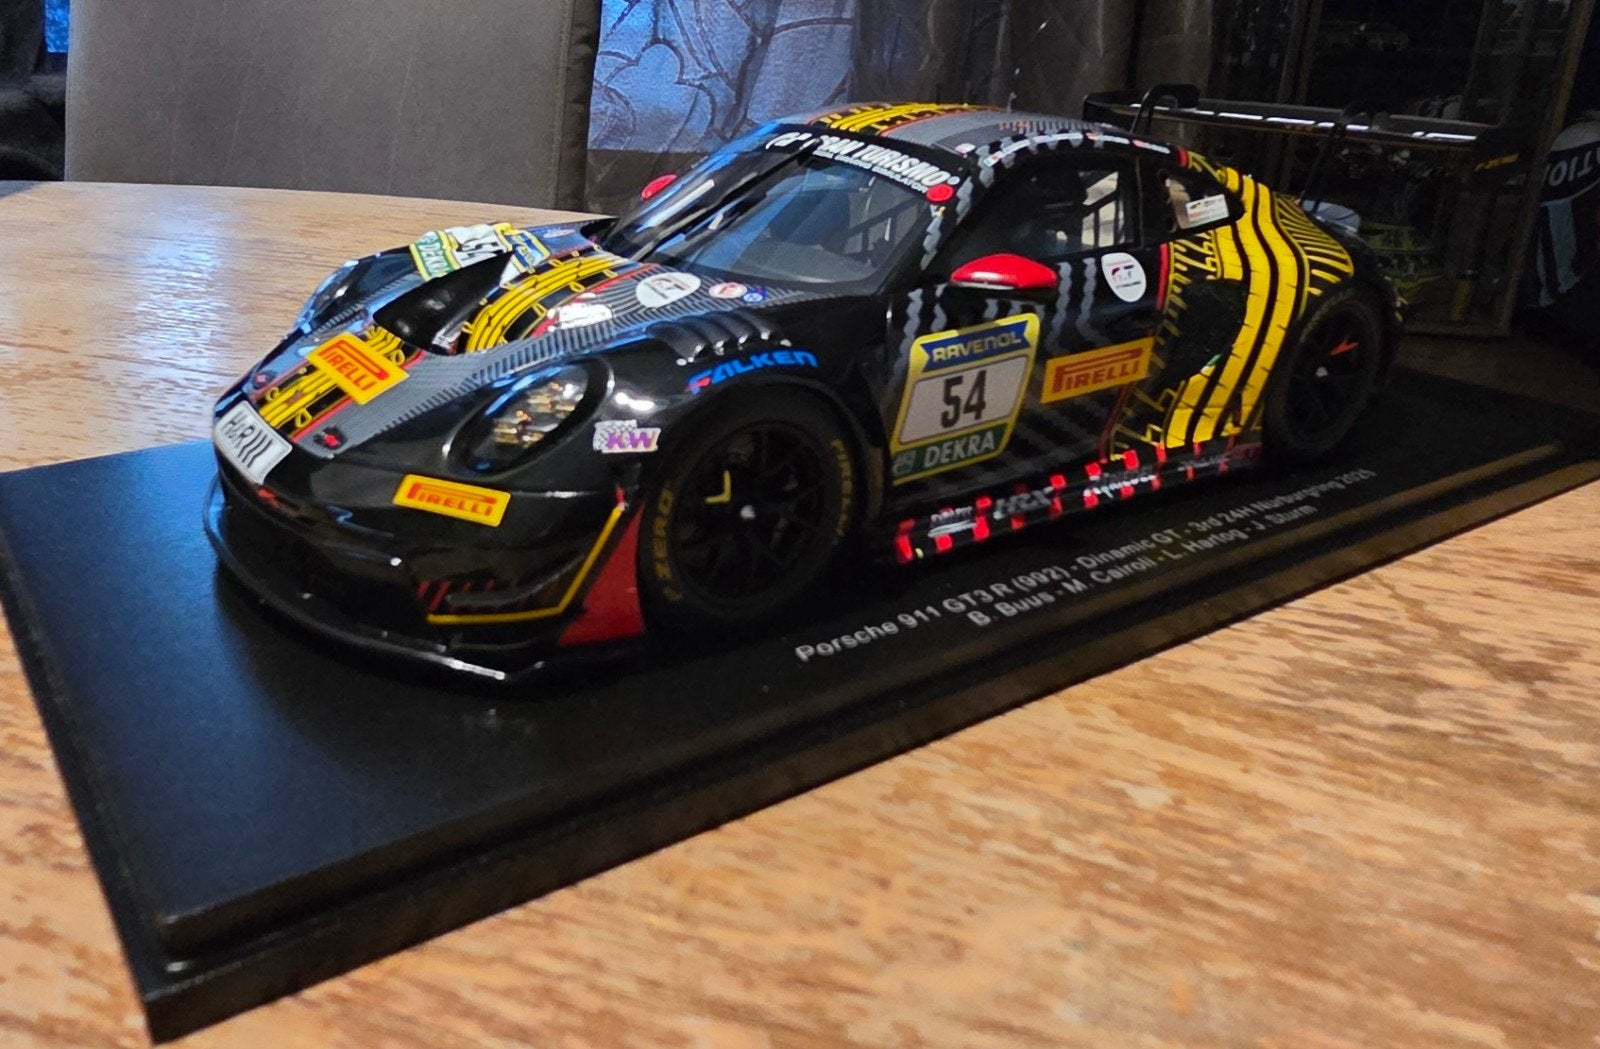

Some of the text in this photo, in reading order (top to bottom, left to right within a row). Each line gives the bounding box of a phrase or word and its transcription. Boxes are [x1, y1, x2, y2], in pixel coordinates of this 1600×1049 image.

[318, 339, 390, 391] PIRELLI
[932, 331, 1022, 363] RAVENOL
[684, 350, 819, 395] FALKEN
[1052, 347, 1144, 394] PIRELLI
[940, 370, 987, 429] 54
[606, 431, 656, 450] KW
[924, 431, 995, 468] DEKRA
[407, 482, 498, 517] PIRELLI
[795, 620, 900, 662] Porsche
[897, 605, 942, 629] 911
[942, 589, 994, 613] GT3
[989, 582, 1014, 598] R
[1011, 565, 1071, 593] (992)
[1075, 538, 1157, 569] Dinamic
[1150, 528, 1182, 545] GT
[1187, 516, 1224, 532] 3rd
[1216, 505, 1258, 523] 24H
[994, 591, 1055, 618] Buus
[1090, 556, 1158, 584] Cairoli
[1180, 528, 1250, 554] Hartog
